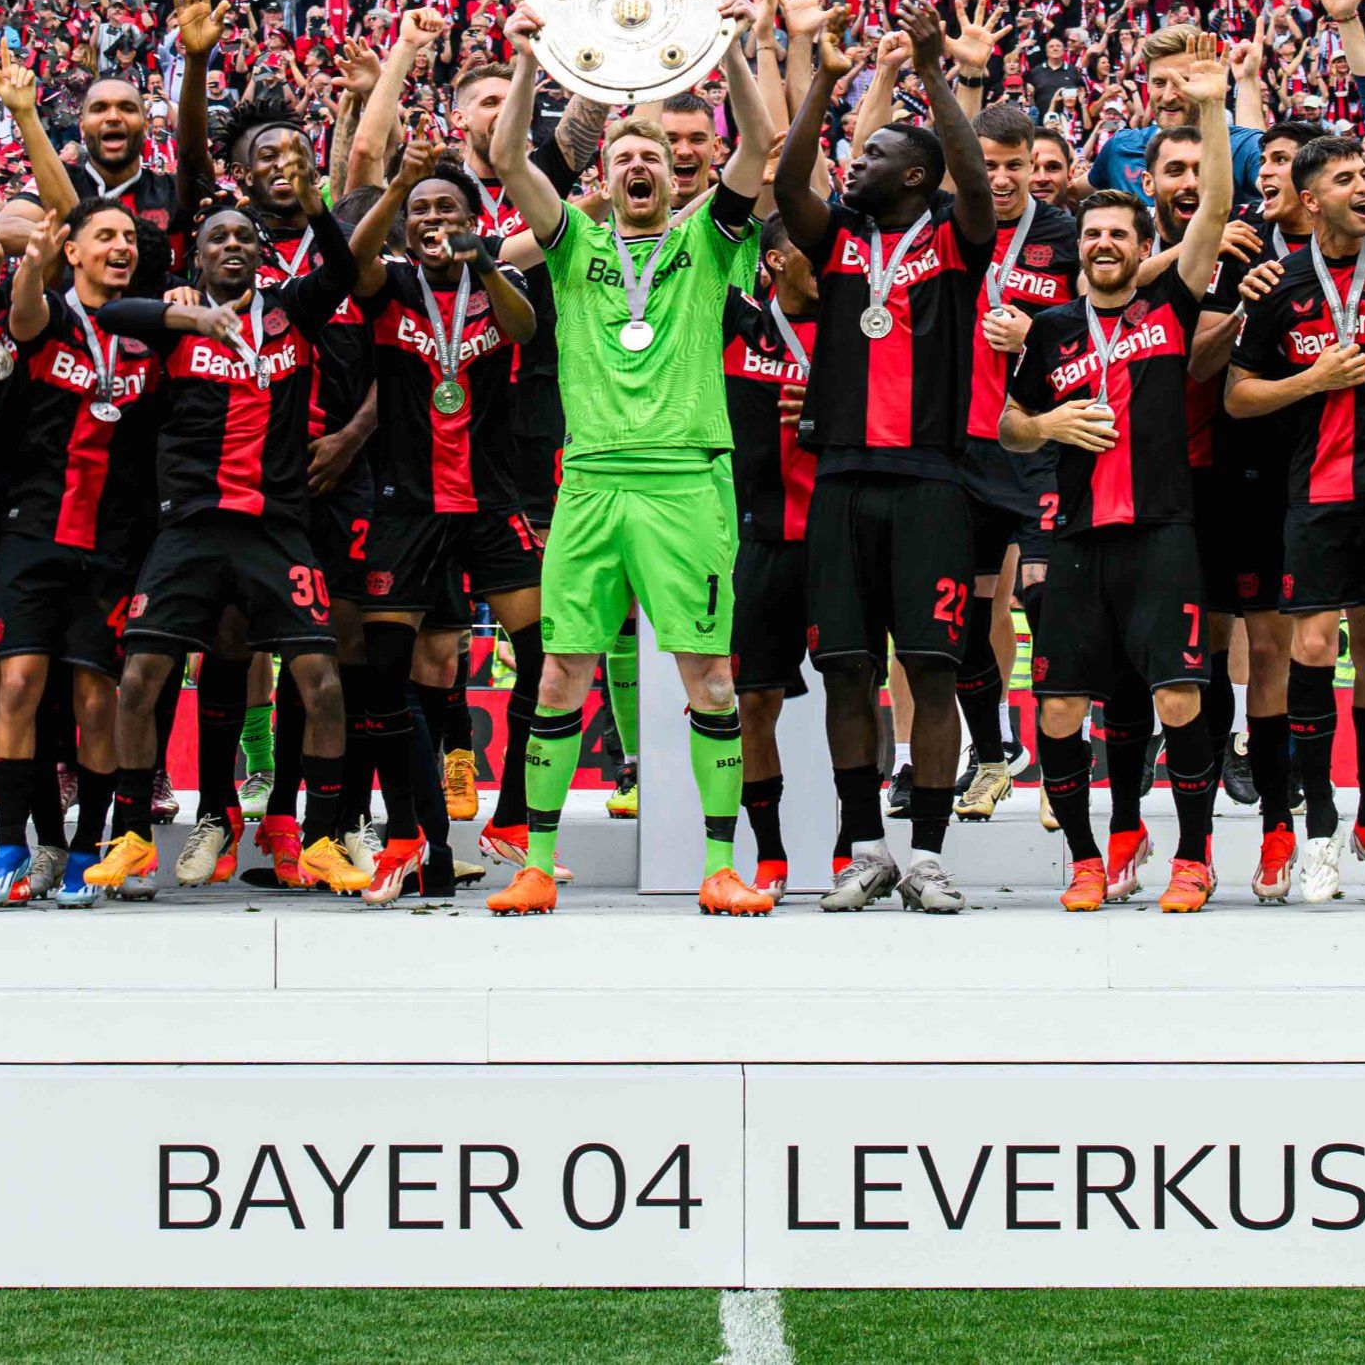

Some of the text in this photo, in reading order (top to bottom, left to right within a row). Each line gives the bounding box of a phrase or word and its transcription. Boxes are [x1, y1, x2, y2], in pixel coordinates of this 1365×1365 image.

[289, 565, 330, 607] 30
[706, 575, 720, 616] 1
[933, 577, 968, 627] 22
[1183, 603, 1201, 647] 7
[715, 755, 742, 770] B04
[160, 1144, 523, 1230] BAYER
[563, 1143, 703, 1231] 04
